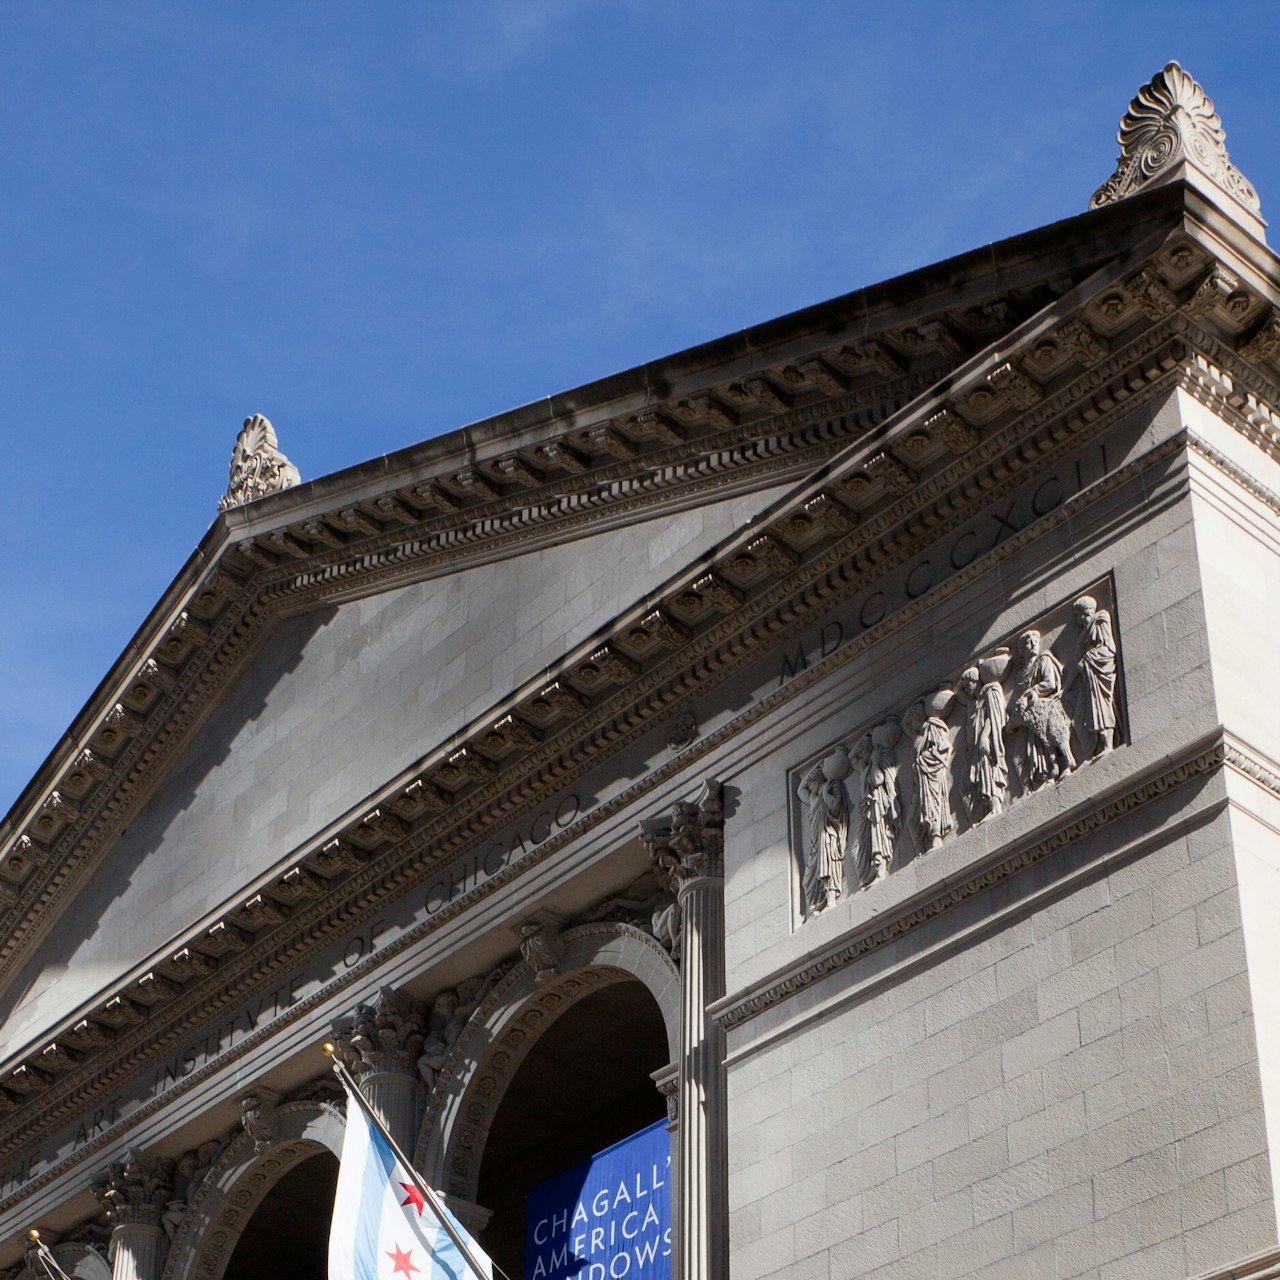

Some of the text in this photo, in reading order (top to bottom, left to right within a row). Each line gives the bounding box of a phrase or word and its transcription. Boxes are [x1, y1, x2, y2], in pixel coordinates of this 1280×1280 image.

[0, 794, 580, 1199] THE ART INSTITVTE OF CHICAGO
